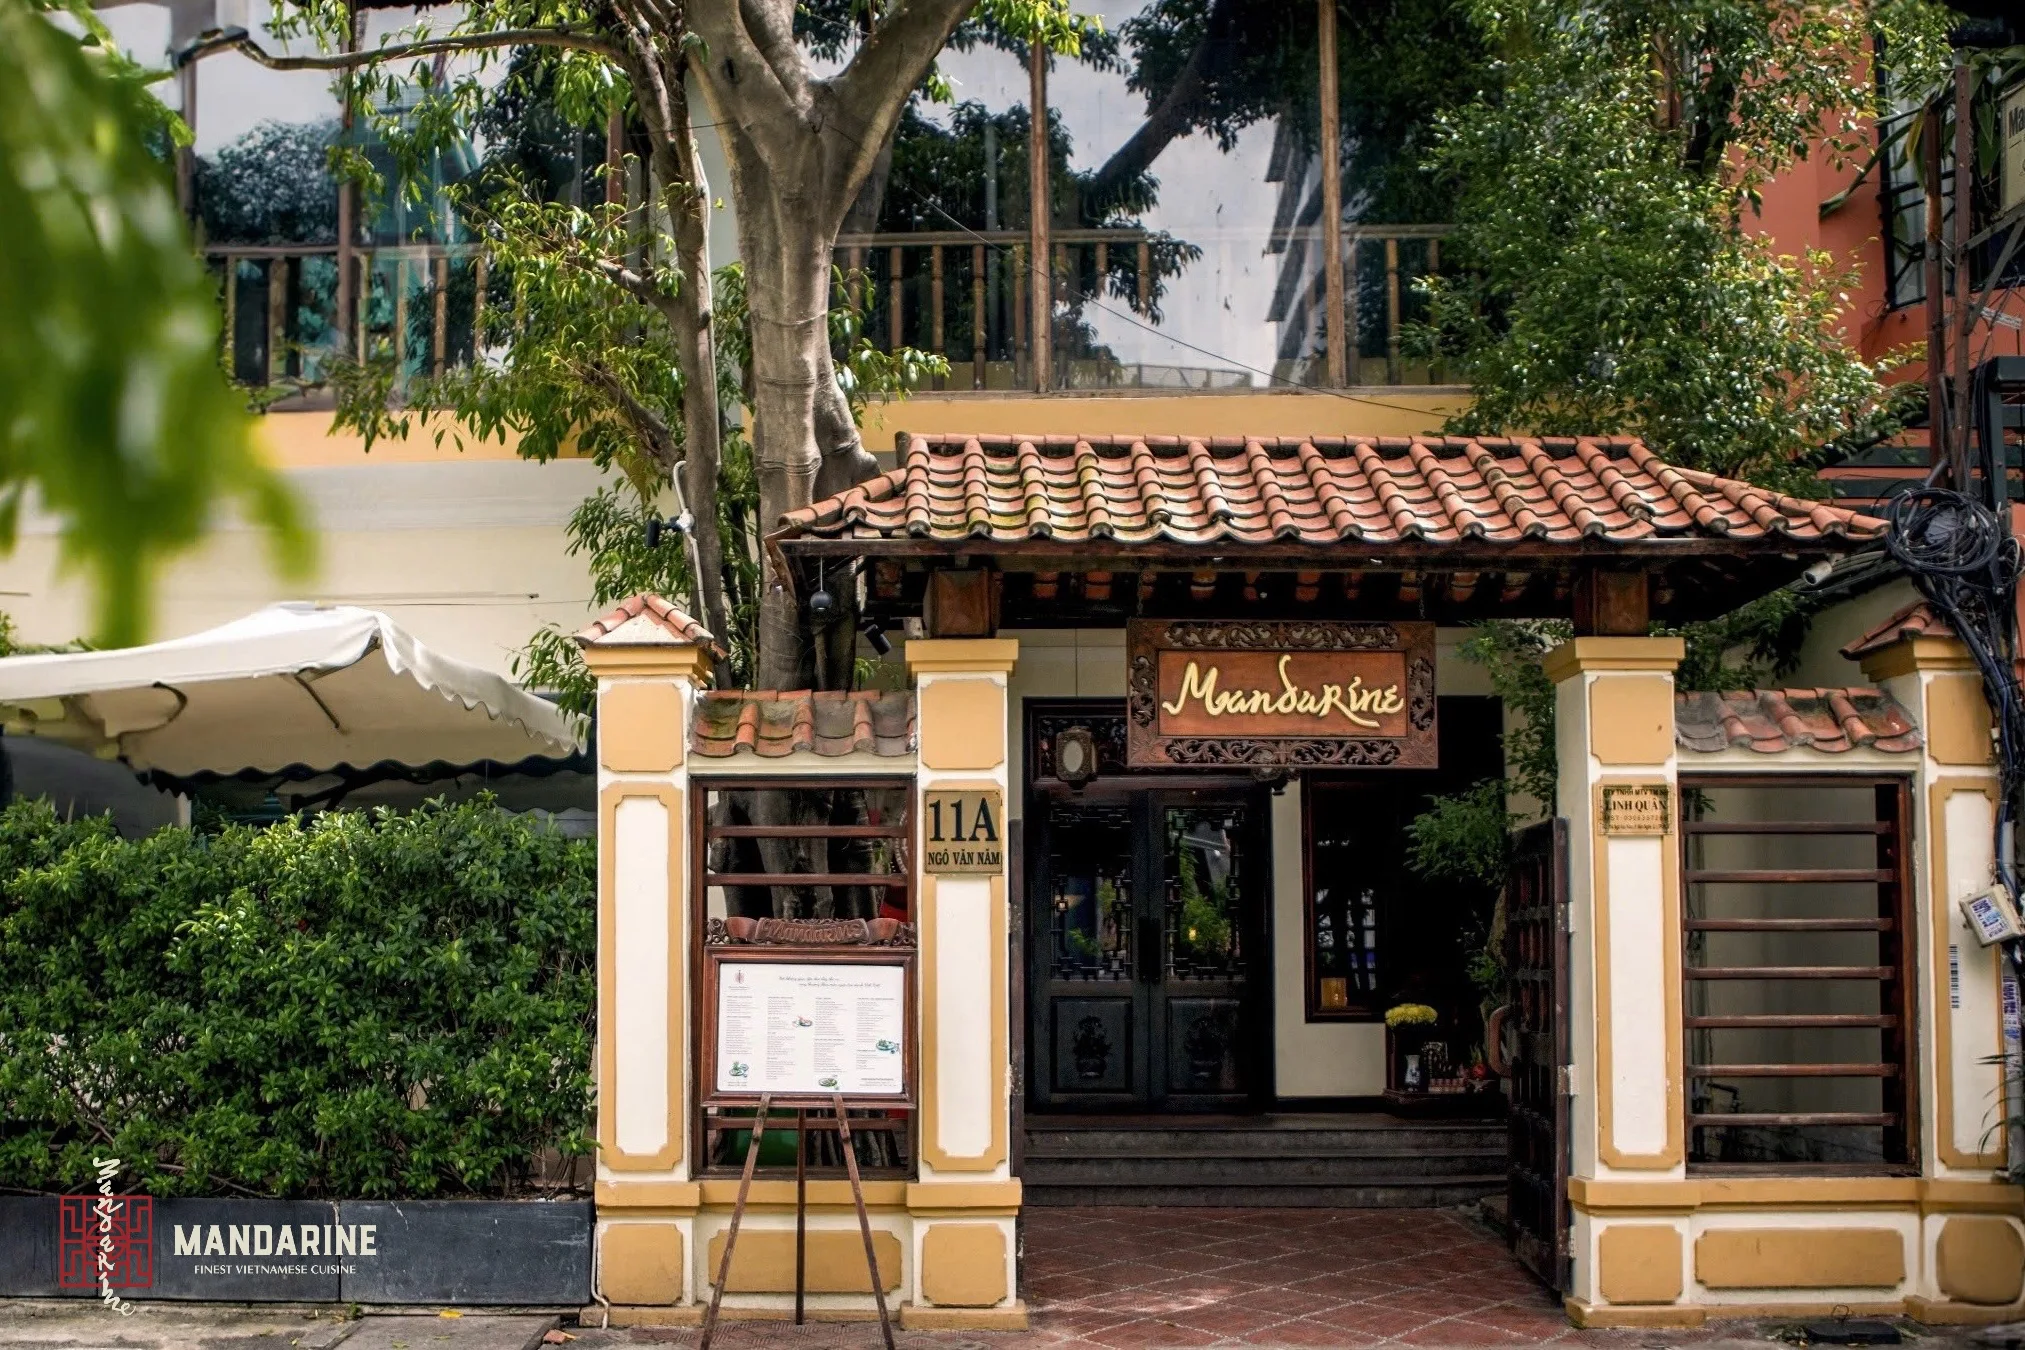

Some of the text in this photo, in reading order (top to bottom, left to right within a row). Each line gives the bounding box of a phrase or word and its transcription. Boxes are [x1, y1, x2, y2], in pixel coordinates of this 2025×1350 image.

[1605, 797, 1667, 812] LINH QUÂN
[929, 797, 998, 842] 11A
[928, 848, 1000, 865] NGÔ VĂN NĂM
